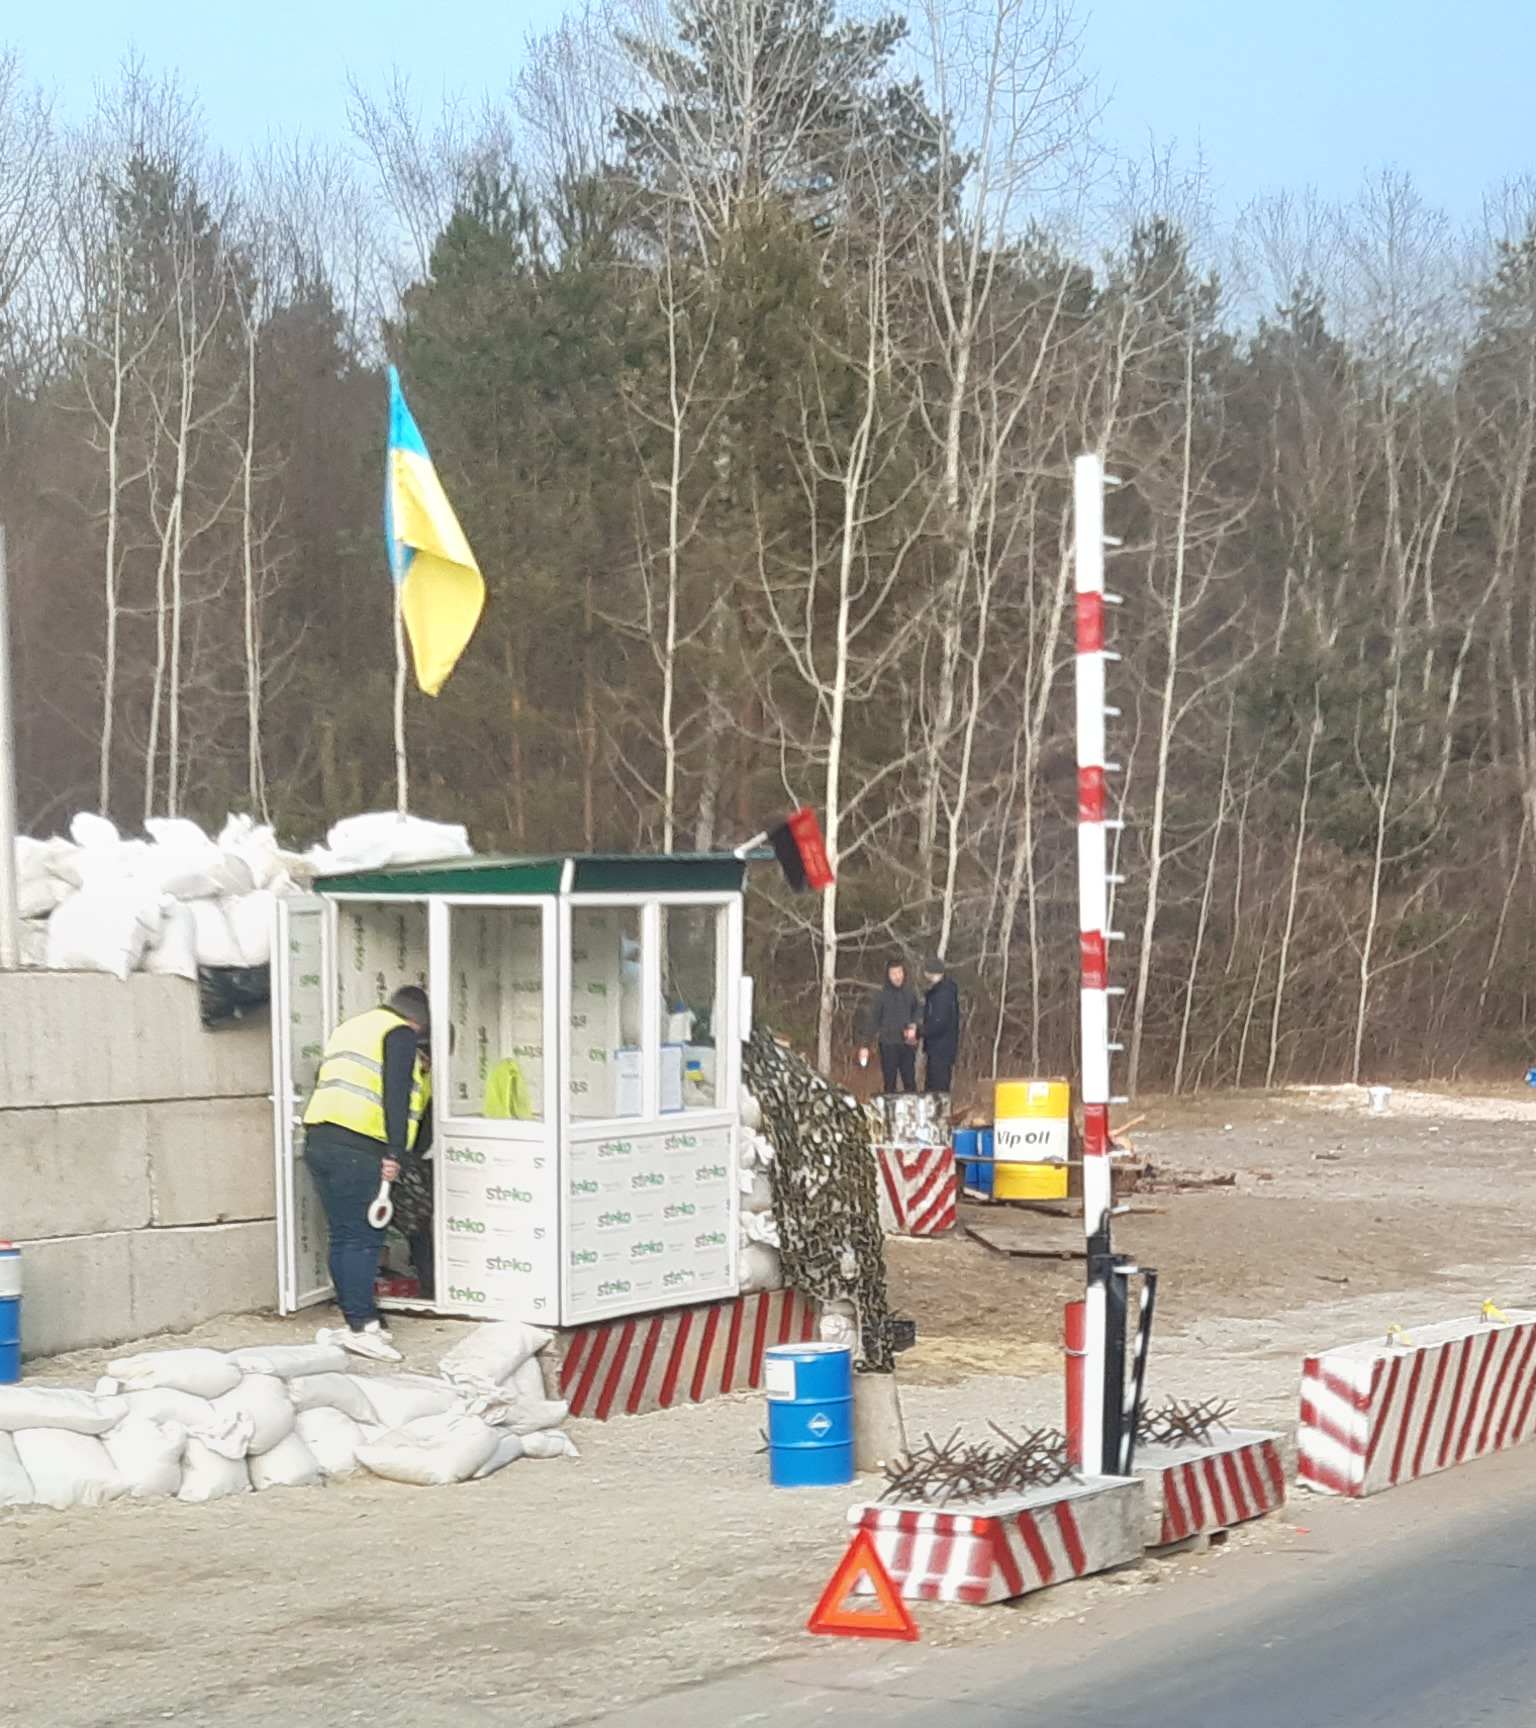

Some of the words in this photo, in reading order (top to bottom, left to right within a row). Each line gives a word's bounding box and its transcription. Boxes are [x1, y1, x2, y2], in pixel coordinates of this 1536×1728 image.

[997, 1131, 1022, 1149] Vip
[445, 1147, 486, 1164] teko
[485, 1185, 533, 1203] steko
[447, 1216, 486, 1234] teko
[485, 1256, 533, 1273] steko
[447, 1286, 486, 1303] teko
